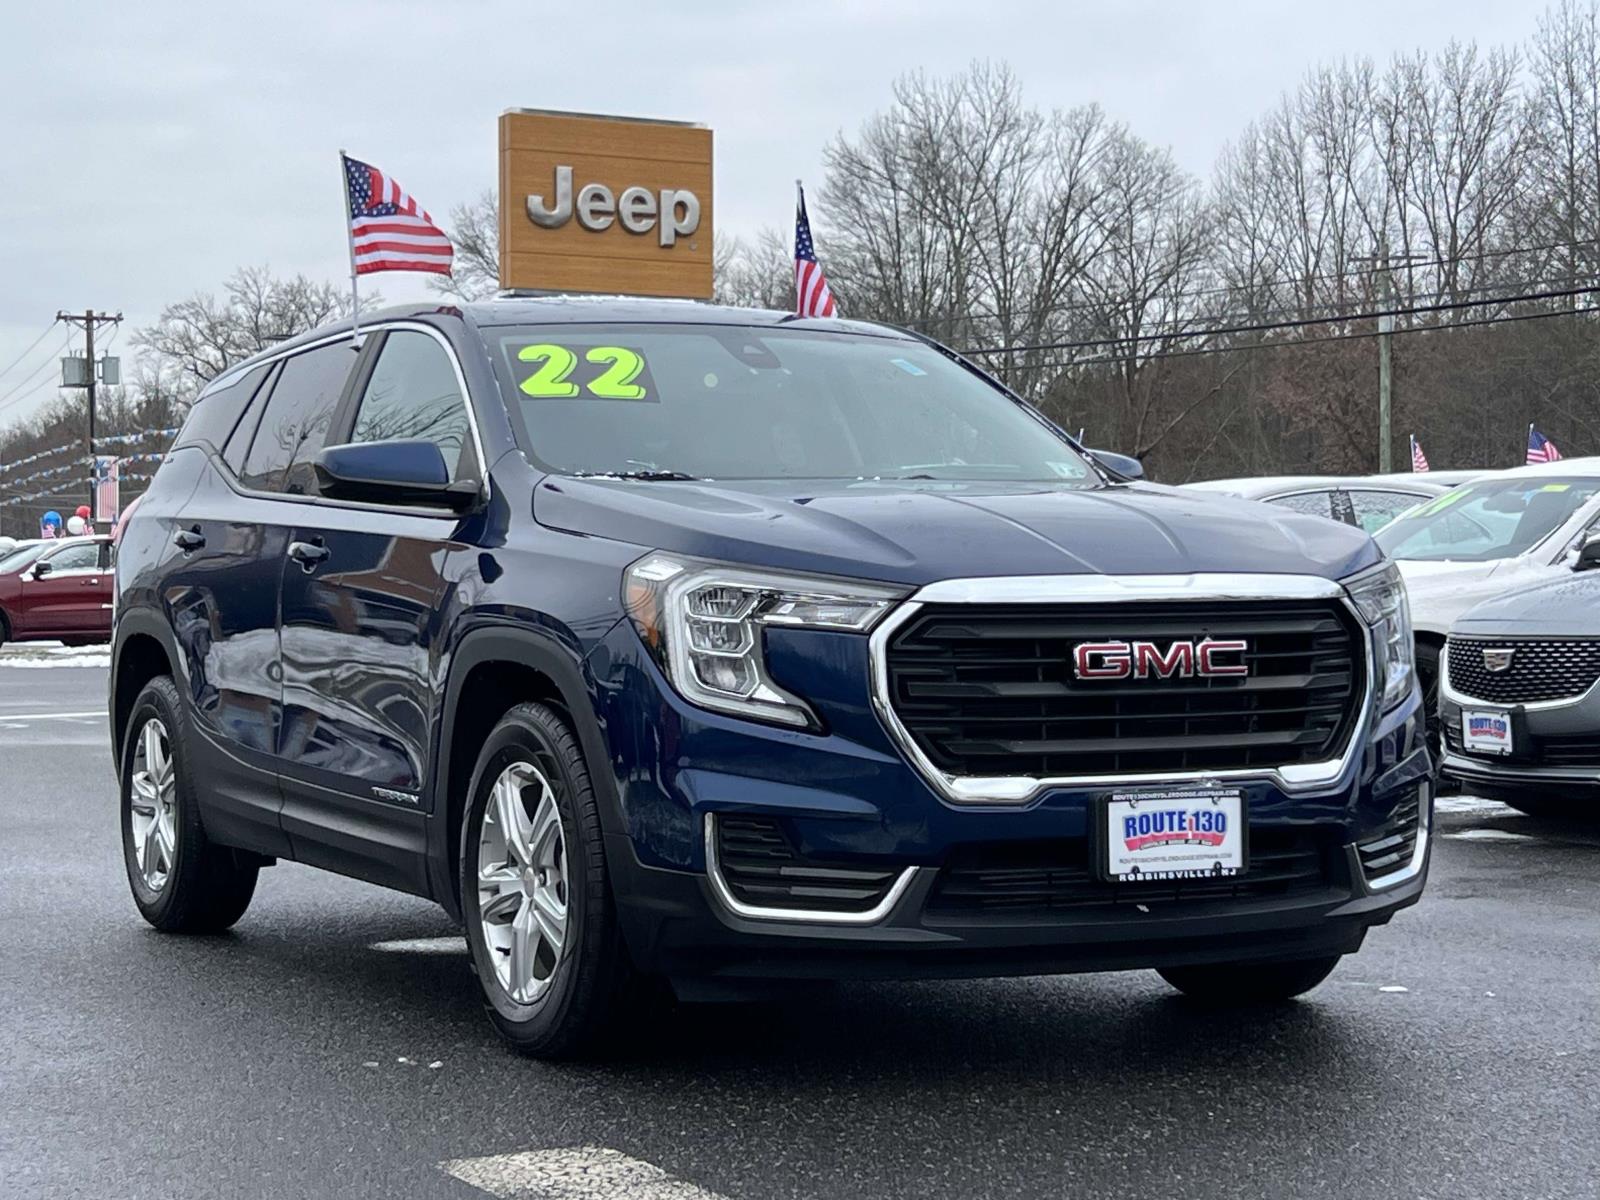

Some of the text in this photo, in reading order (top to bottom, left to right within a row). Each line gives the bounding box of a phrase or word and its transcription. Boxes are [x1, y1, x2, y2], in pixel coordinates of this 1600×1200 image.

[527, 165, 701, 248] Jeep
[517, 344, 647, 400] 22
[1073, 640, 1249, 680] GMC
[1124, 811, 1227, 839] ROUTE 130
[1220, 868, 1237, 877] NJ
